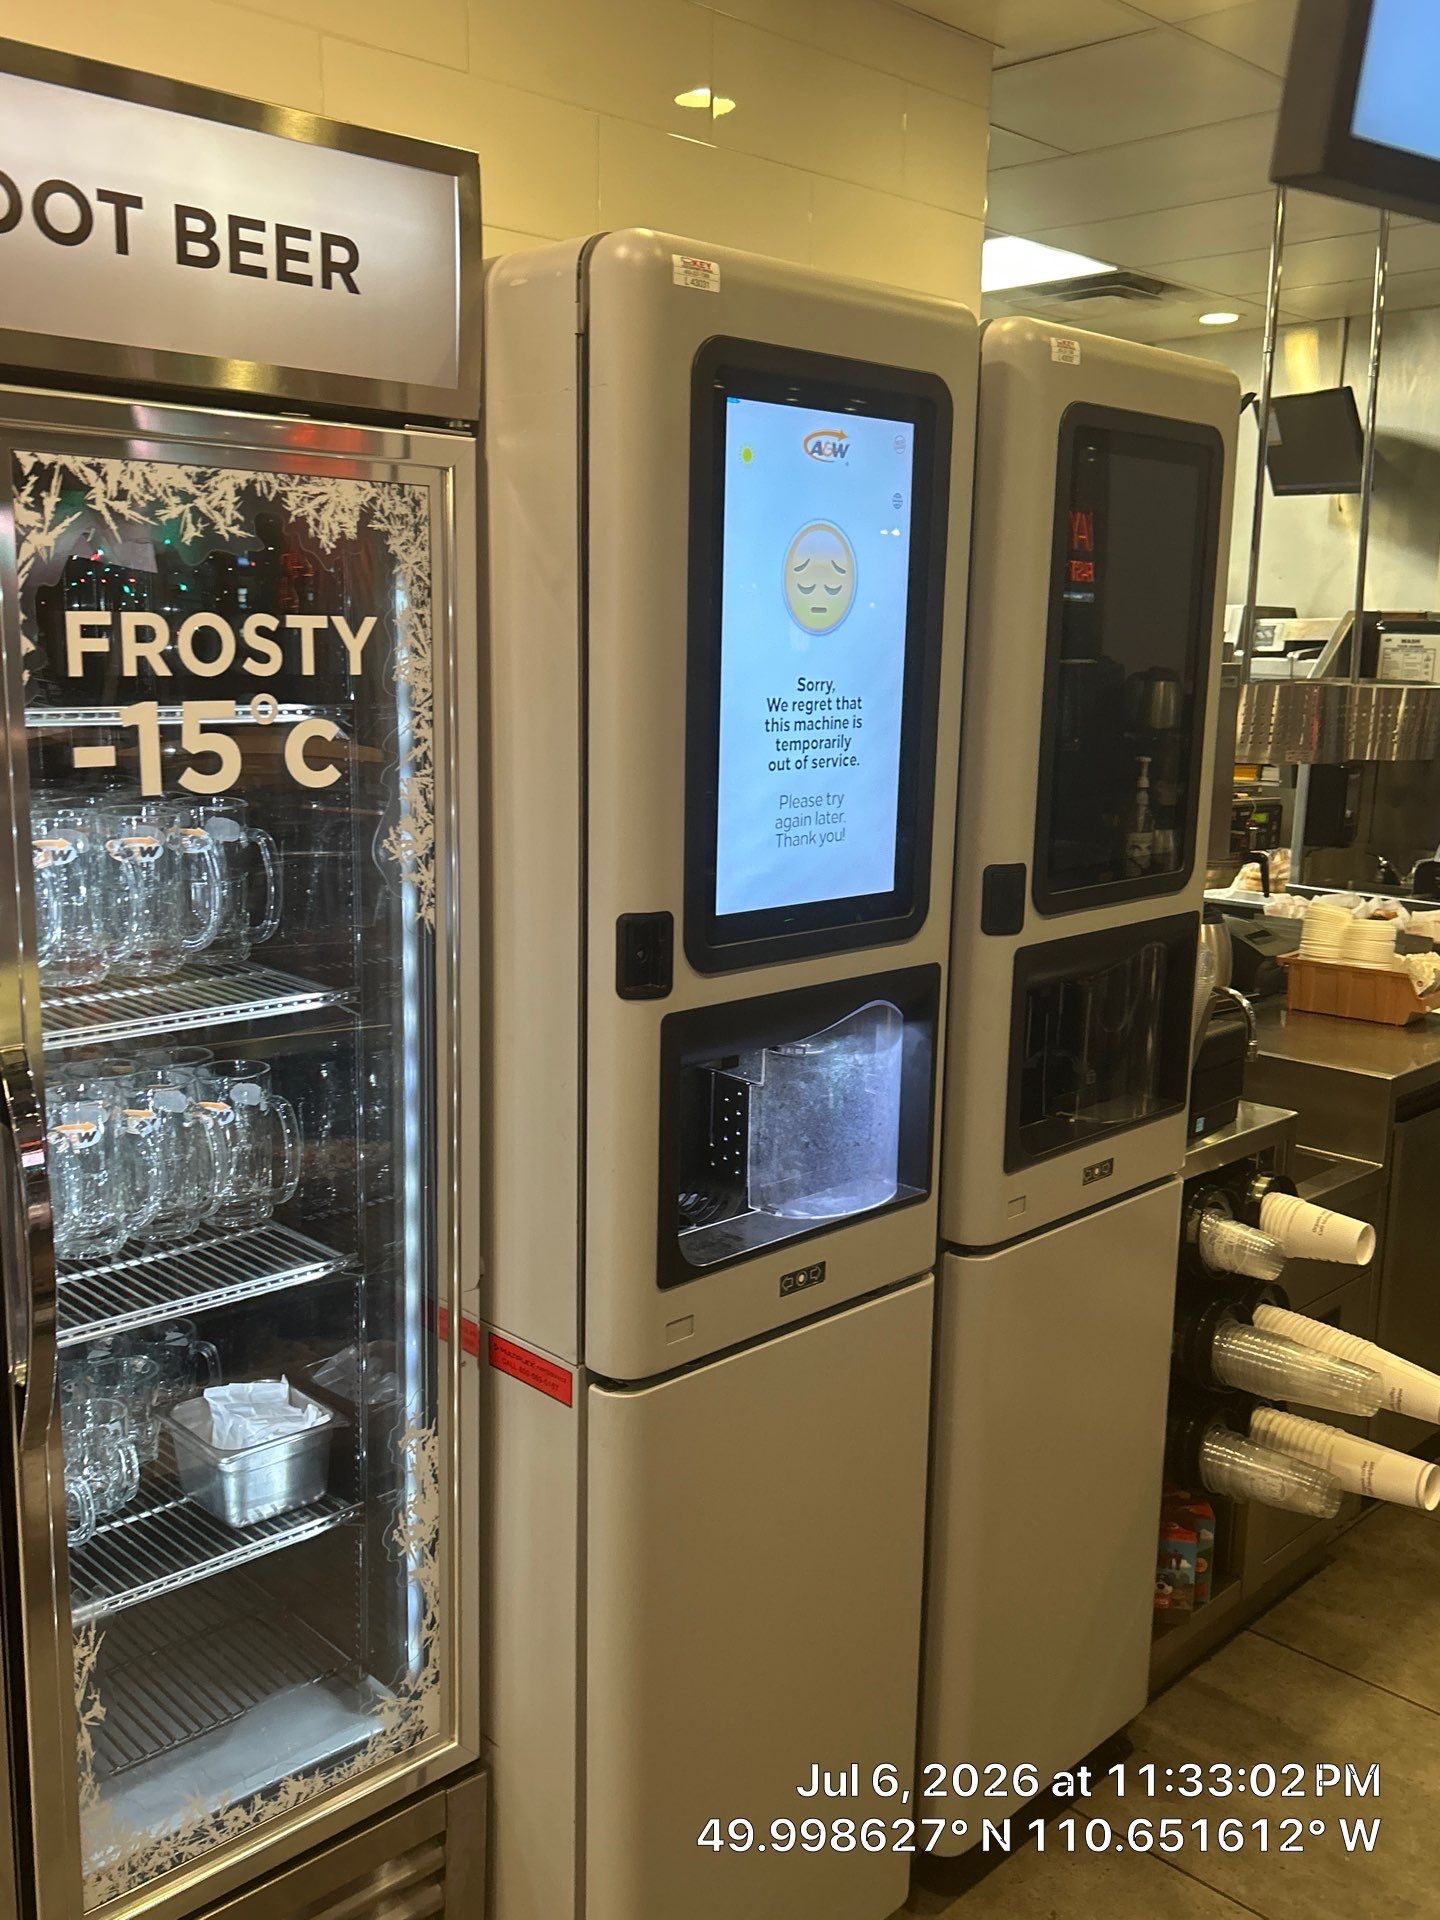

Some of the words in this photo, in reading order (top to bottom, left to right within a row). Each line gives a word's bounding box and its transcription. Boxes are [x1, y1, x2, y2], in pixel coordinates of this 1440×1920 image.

[174, 203, 361, 295] BEER
[65, 610, 378, 678] FROSTY
[797, 677, 835, 695] Sorry,
[766, 697, 788, 712] We
[792, 698, 832, 715] regret
[836, 696, 862, 710] that
[765, 718, 790, 732] this
[794, 716, 849, 731] machine
[853, 715, 863, 729] is
[776, 734, 852, 754] temporarily
[768, 758, 791, 771] out
[795, 755, 809, 769] of
[812, 753, 860, 768] service.
[779, 794, 823, 810] Please
[826, 793, 845, 809] try
[775, 814, 812, 832] again
[815, 811, 847, 825] later.
[776, 831, 817, 848] Thank
[819, 827, 846, 847] you!
